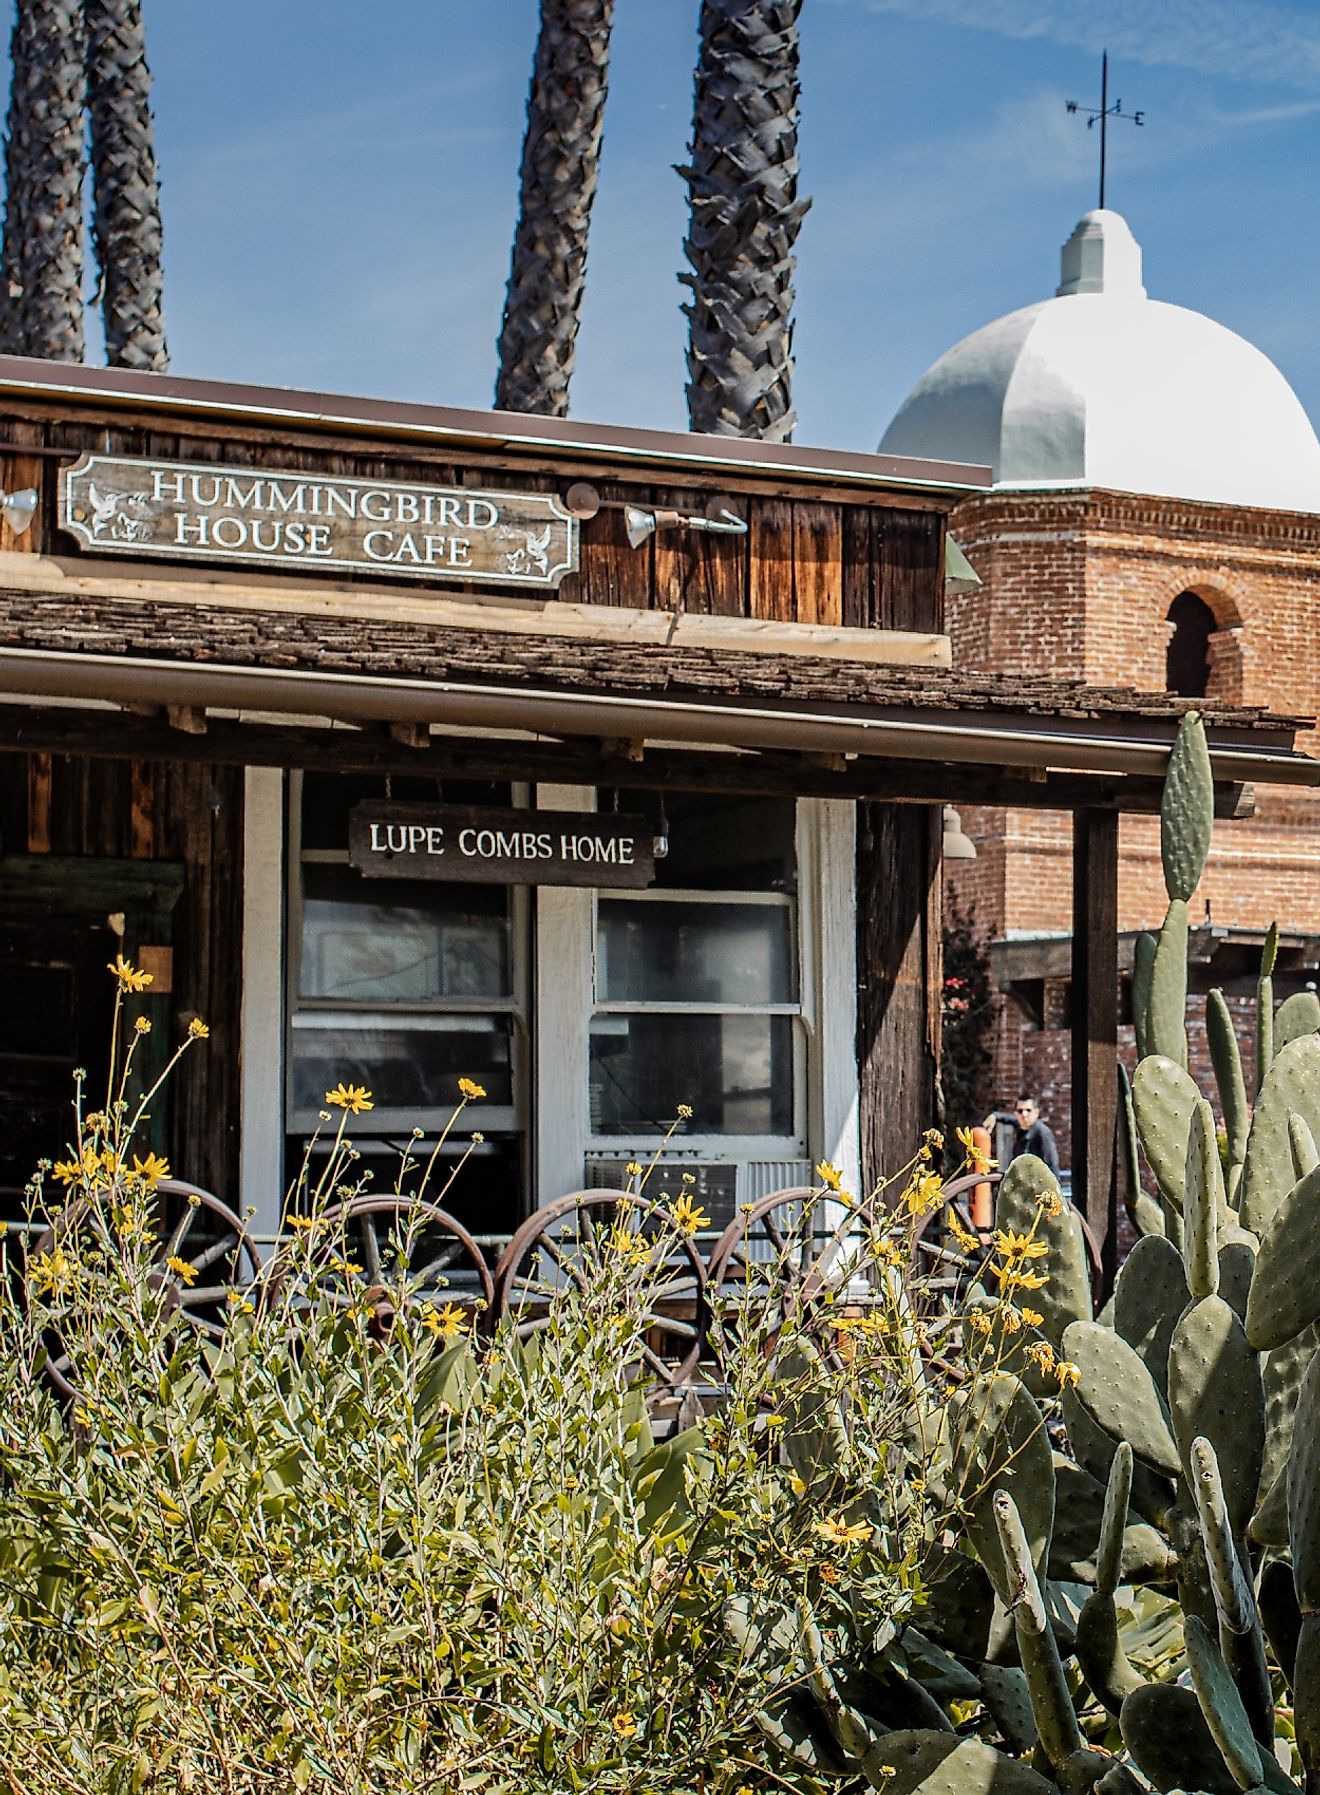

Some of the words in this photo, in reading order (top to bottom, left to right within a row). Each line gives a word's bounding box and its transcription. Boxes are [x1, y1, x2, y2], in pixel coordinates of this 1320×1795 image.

[150, 470, 500, 530] HUMMINGBIRD
[173, 511, 334, 556] HOUSE
[362, 530, 473, 567] CAFE
[369, 823, 445, 855] LUPE
[458, 828, 554, 859] COMBS
[560, 834, 635, 865] HOME
